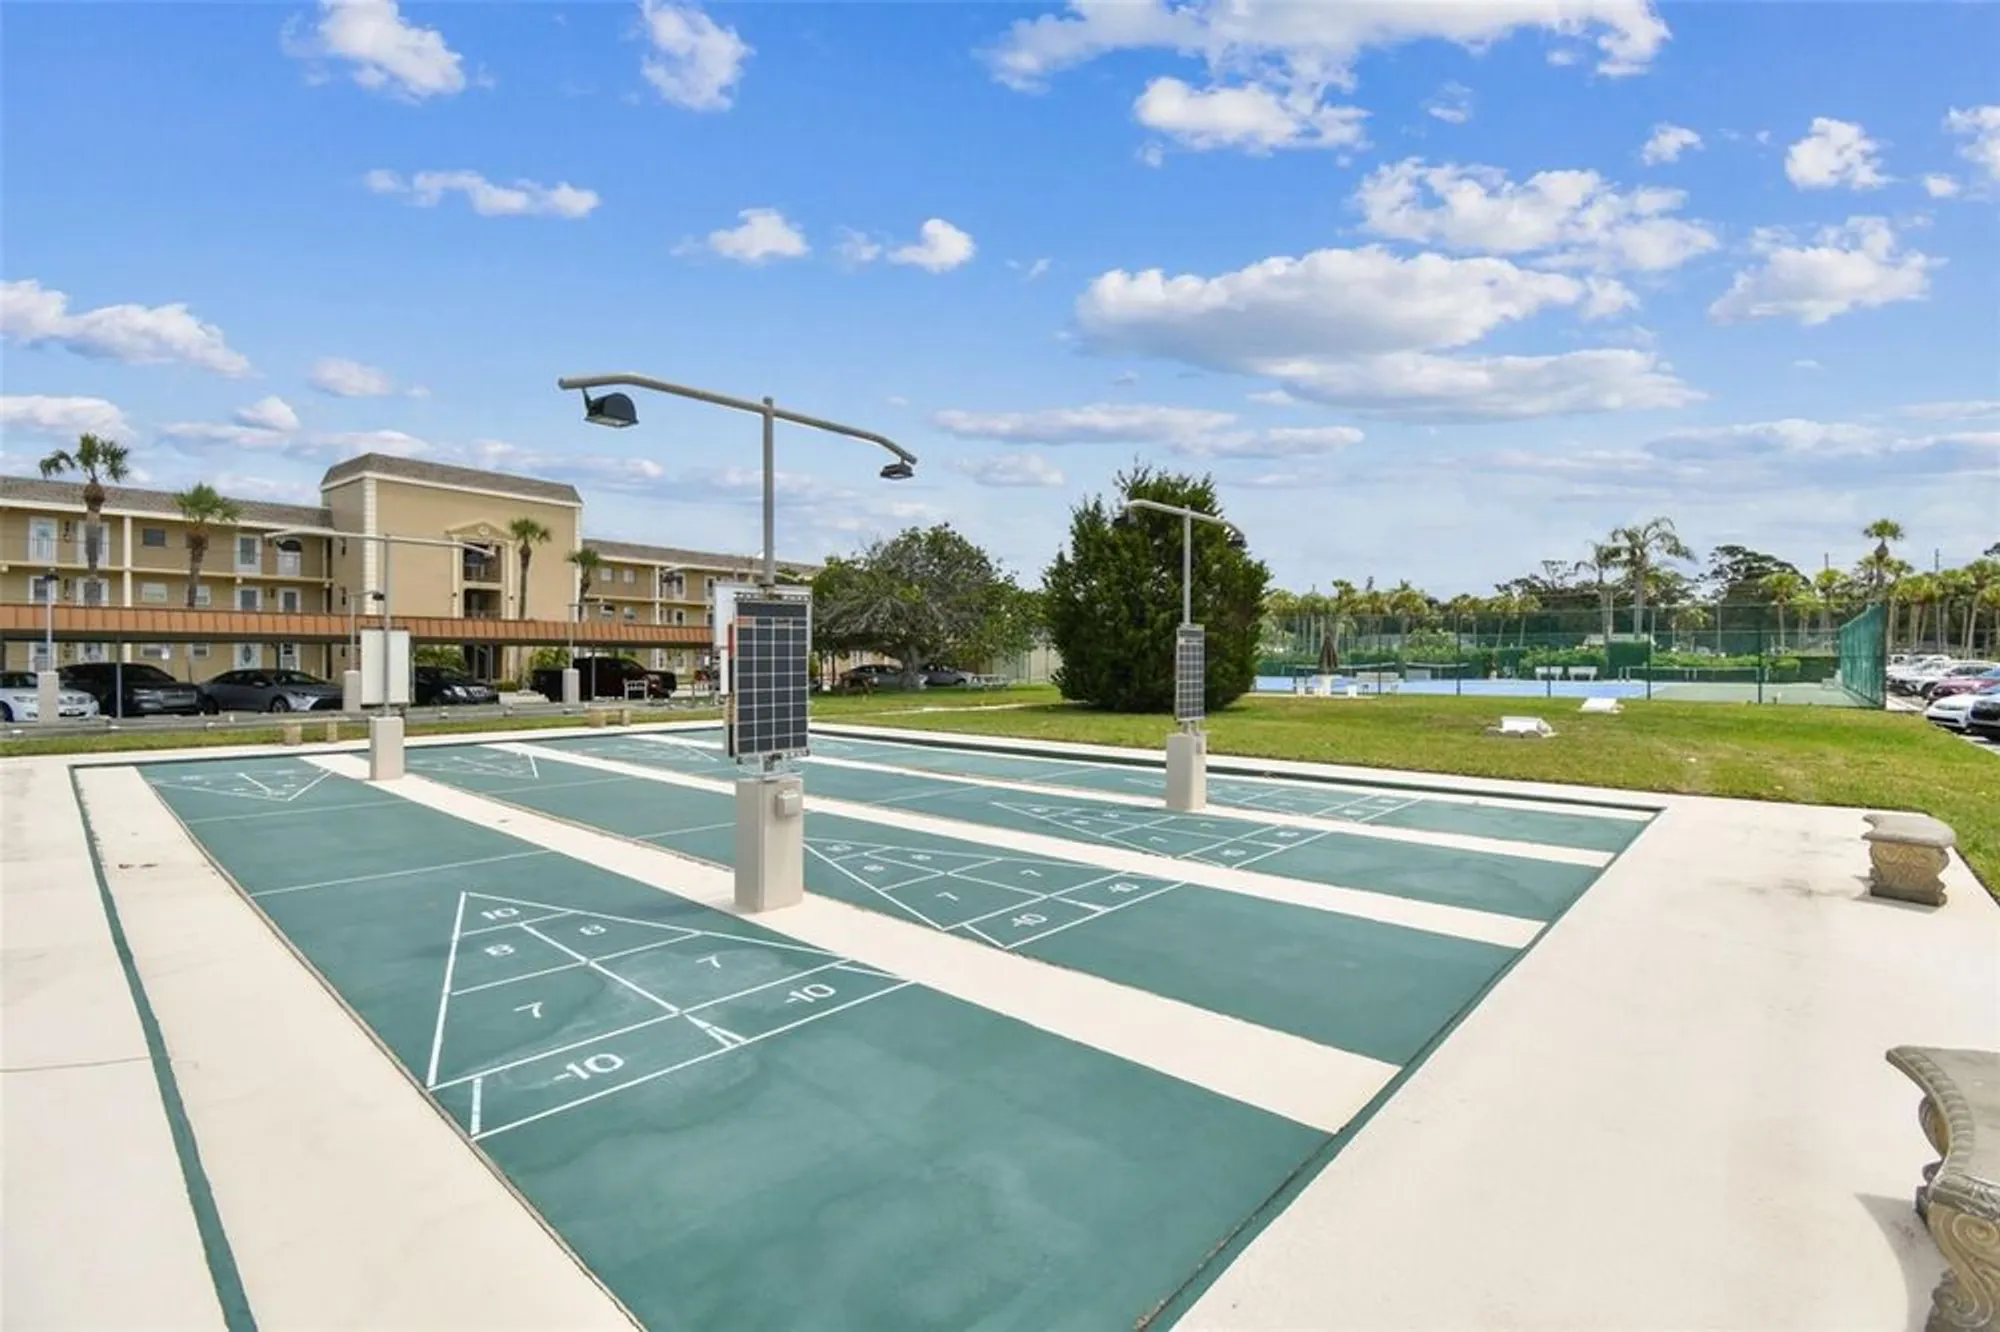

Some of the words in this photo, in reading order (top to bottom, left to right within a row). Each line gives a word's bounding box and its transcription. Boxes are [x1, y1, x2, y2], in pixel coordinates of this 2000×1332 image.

[481, 907, 519, 920] 10
[696, 954, 721, 968] 7
[785, 983, 836, 1003] -10
[513, 1001, 543, 1018] 7
[553, 1053, 624, 1080] -10
